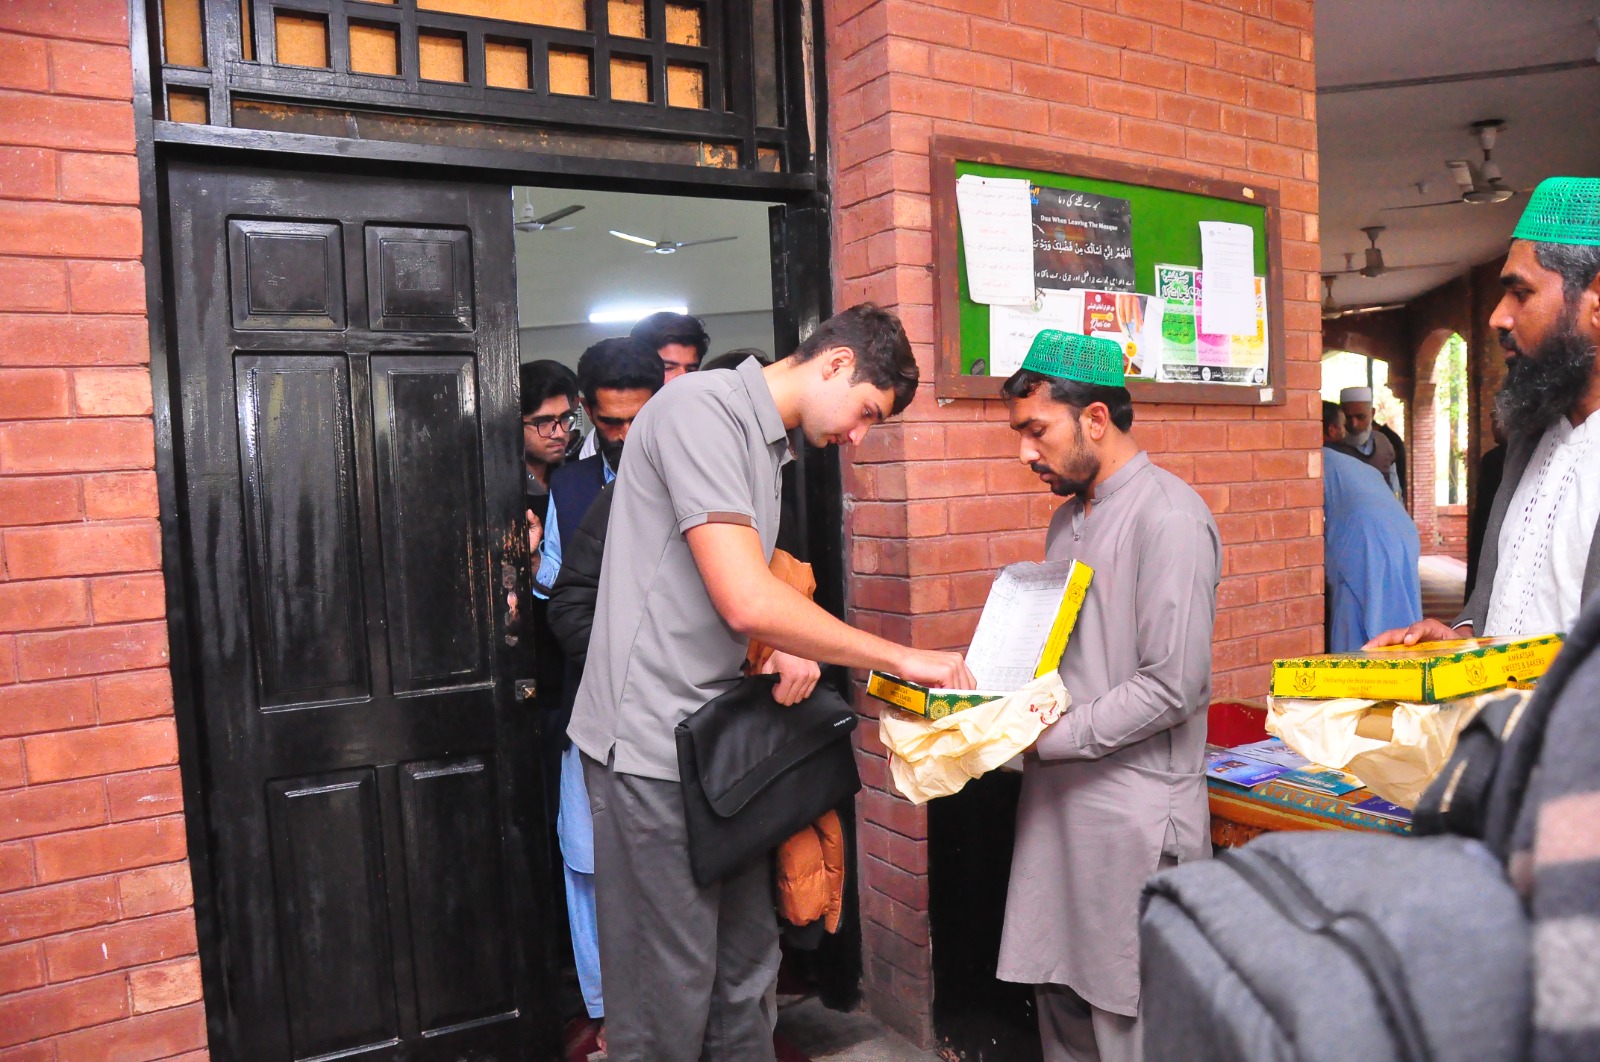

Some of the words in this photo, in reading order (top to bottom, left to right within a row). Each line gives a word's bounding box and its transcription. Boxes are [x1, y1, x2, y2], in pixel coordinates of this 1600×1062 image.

[1040, 214, 1051, 222] Dua
[1052, 216, 1067, 224] When
[1068, 218, 1088, 228] Leaving
[1098, 223, 1118, 231] Mosque
[1507, 650, 1535, 662] AMRATSAR
[1501, 663, 1521, 674] SWEETS
[1526, 658, 1545, 668] BAKERS
